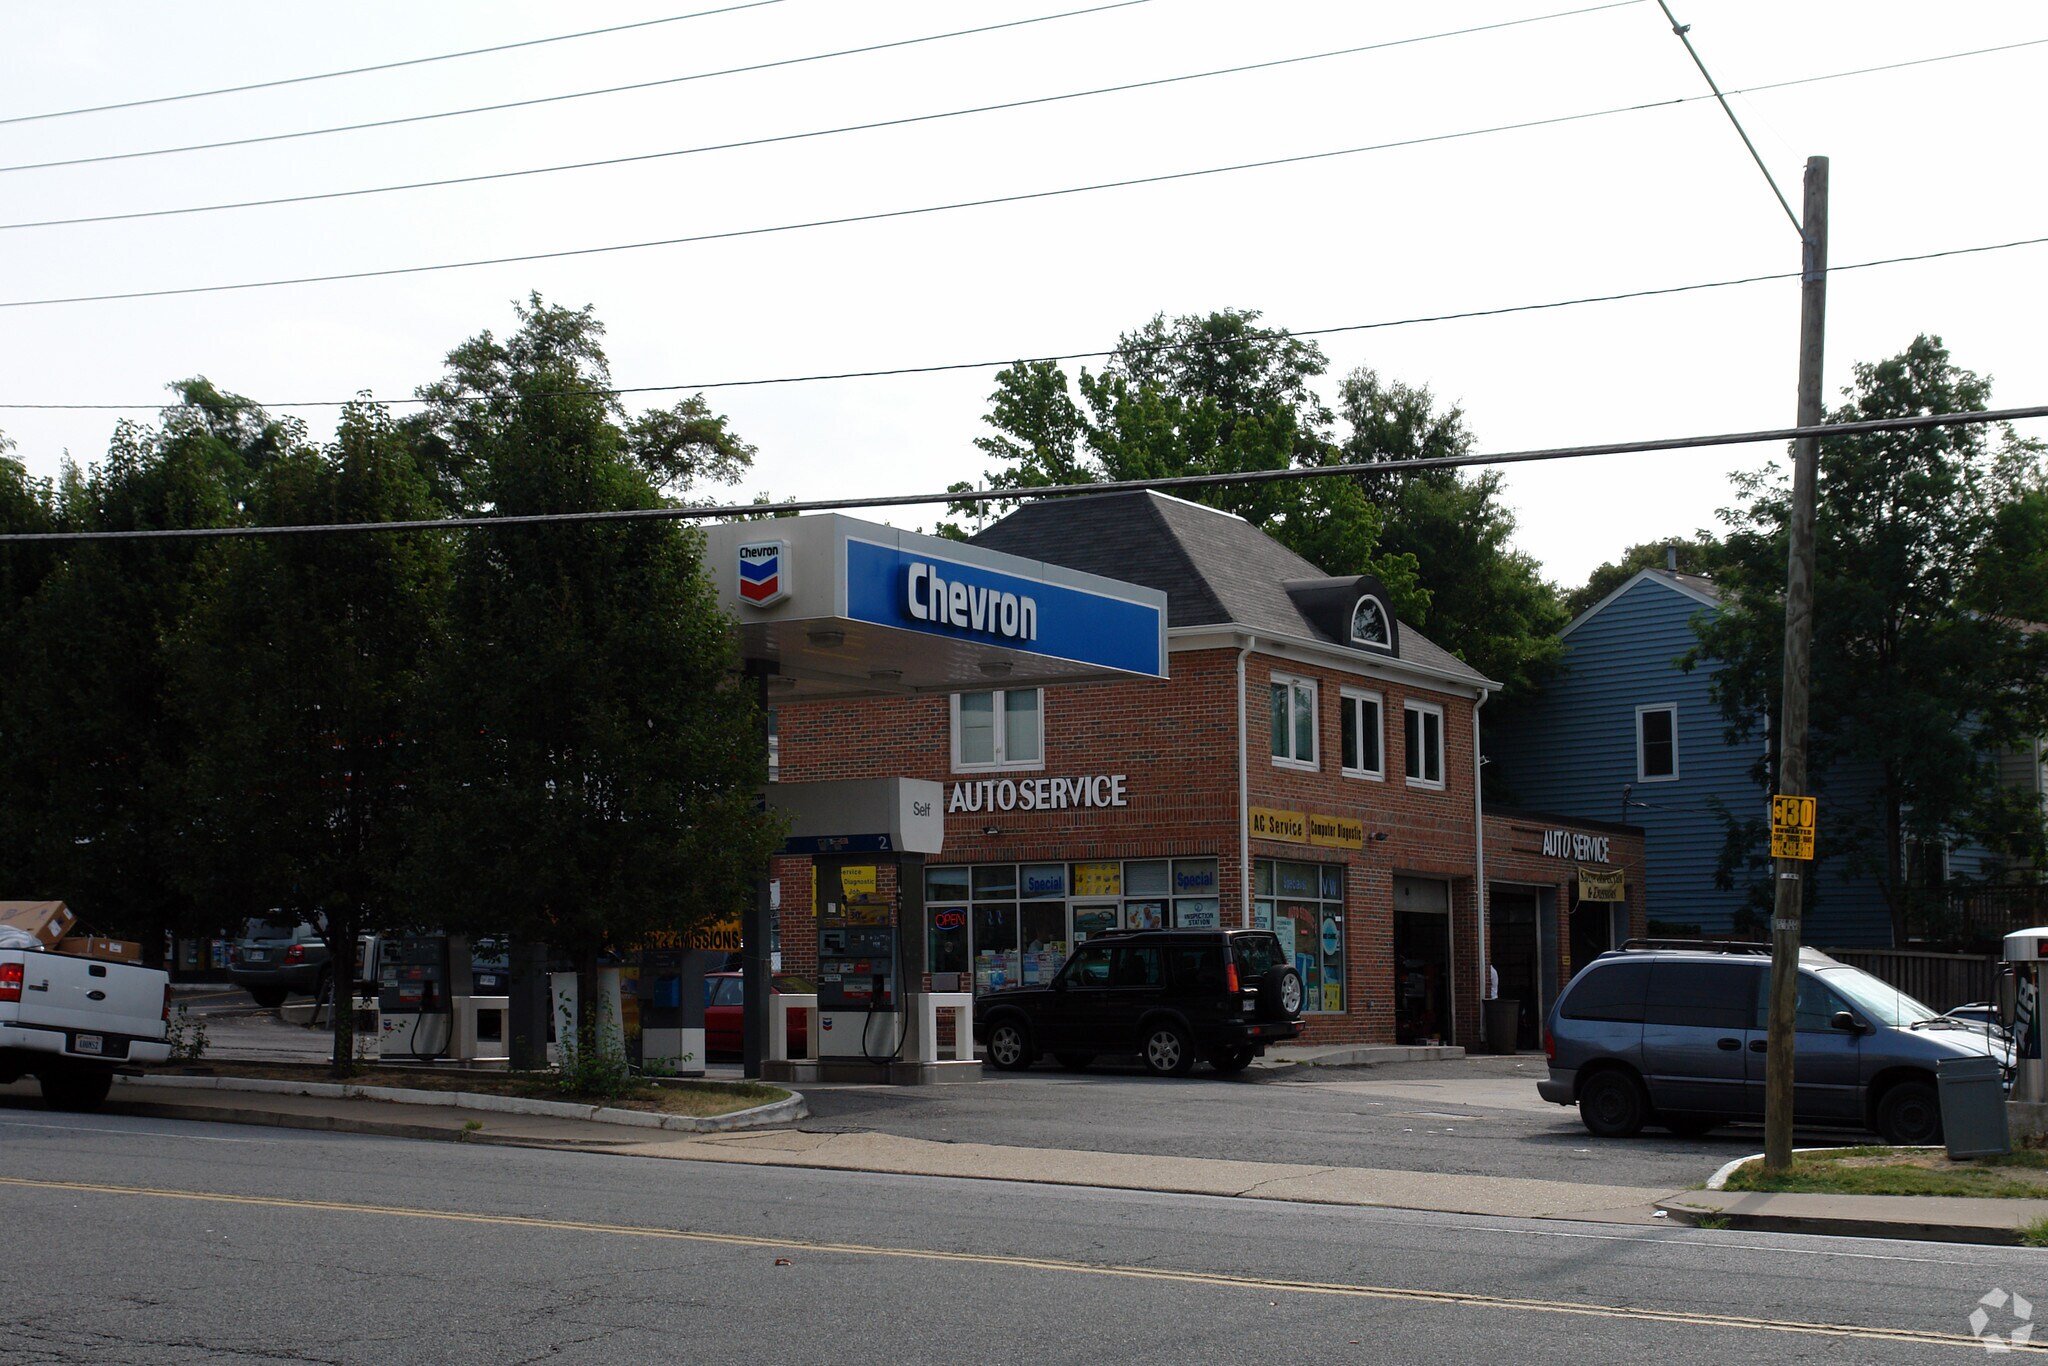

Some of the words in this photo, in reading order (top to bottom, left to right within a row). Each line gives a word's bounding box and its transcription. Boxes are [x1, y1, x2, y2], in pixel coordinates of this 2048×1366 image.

[740, 546, 778, 558] Chevron
[908, 562, 1037, 641] Chevron
[913, 801, 931, 817] Self
[1775, 799, 1813, 827] $130
[1254, 814, 1265, 832] AC
[1269, 816, 1302, 836] Service
[1310, 820, 1336, 838] Computer
[878, 836, 888, 850] 2
[1542, 829, 1571, 859] AUTO
[1572, 832, 1610, 863] SERVICE
[843, 878, 875, 886] Diagnostic
[1028, 876, 1063, 891] Special
[1177, 871, 1213, 890] Special
[935, 913, 965, 926] OPEN
